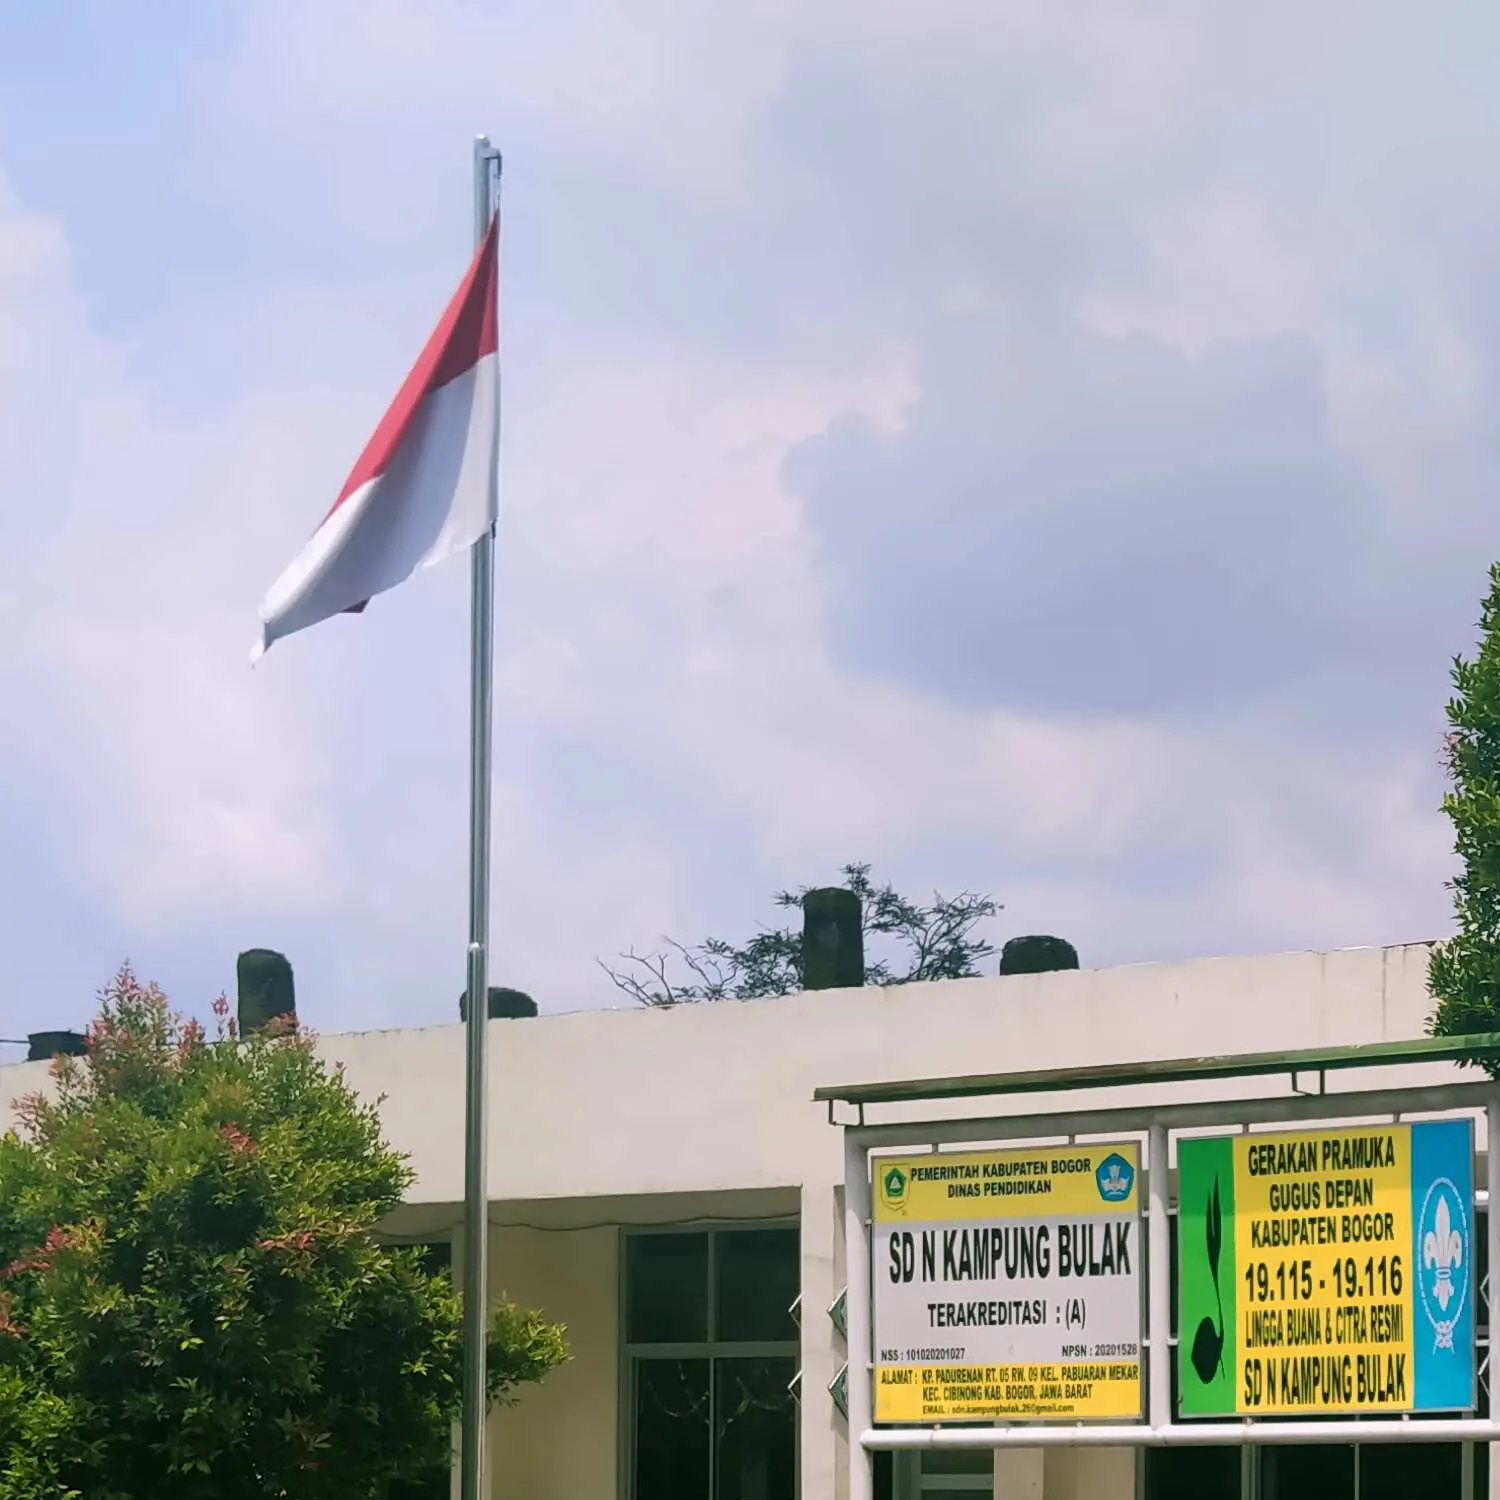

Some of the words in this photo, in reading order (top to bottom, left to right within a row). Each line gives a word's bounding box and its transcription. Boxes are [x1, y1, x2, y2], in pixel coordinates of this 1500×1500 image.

[911, 1164, 979, 1181] PEMERINTAH
[983, 1161, 1048, 1178] KABUPATEN
[1051, 1158, 1092, 1174] BOGOR
[1249, 1142, 1318, 1176] GERAKAN
[1322, 1136, 1395, 1171] PRAMUKA
[948, 1184, 981, 1198] DINAS
[984, 1180, 1052, 1196] PENDIDIKAN
[1269, 1180, 1320, 1212] GUGUS
[1325, 1178, 1373, 1208] DEPAN
[1251, 1216, 1337, 1248] KABUPATEN
[1342, 1213, 1395, 1242] BOGOR
[889, 1231, 915, 1284] SD
[922, 1231, 936, 1282] N
[943, 1225, 1051, 1281] KAMPUNG
[1058, 1222, 1132, 1278] BULAK
[1245, 1260, 1313, 1302] 19.115
[1333, 1256, 1403, 1297] 19.116
[928, 1300, 1046, 1327] TERAKREDITASI
[1065, 1298, 1086, 1330] (A)
[1245, 1310, 1284, 1348] LINGGA
[1287, 1308, 1322, 1346] BUANA
[1325, 1307, 1332, 1344] &
[1336, 1305, 1368, 1343] CITRA
[1370, 1304, 1403, 1342] RESMI
[881, 1349, 899, 1361] NSS
[1062, 1344, 1087, 1357] NPSN
[1094, 1343, 1138, 1356] 20201528
[881, 1369, 913, 1384] ALAMAT
[936, 1368, 983, 1384] PADURENAN
[1062, 1365, 1107, 1381] PABUARAN
[1245, 1358, 1262, 1406] SD
[1266, 1358, 1276, 1405] N
[1281, 1354, 1353, 1405] KAMPUNG
[1356, 1353, 1406, 1402] BULAK
[943, 1385, 982, 1401] CIBINONG
[1039, 1384, 1063, 1400] JAWA
[1065, 1383, 1093, 1399] BARAT
